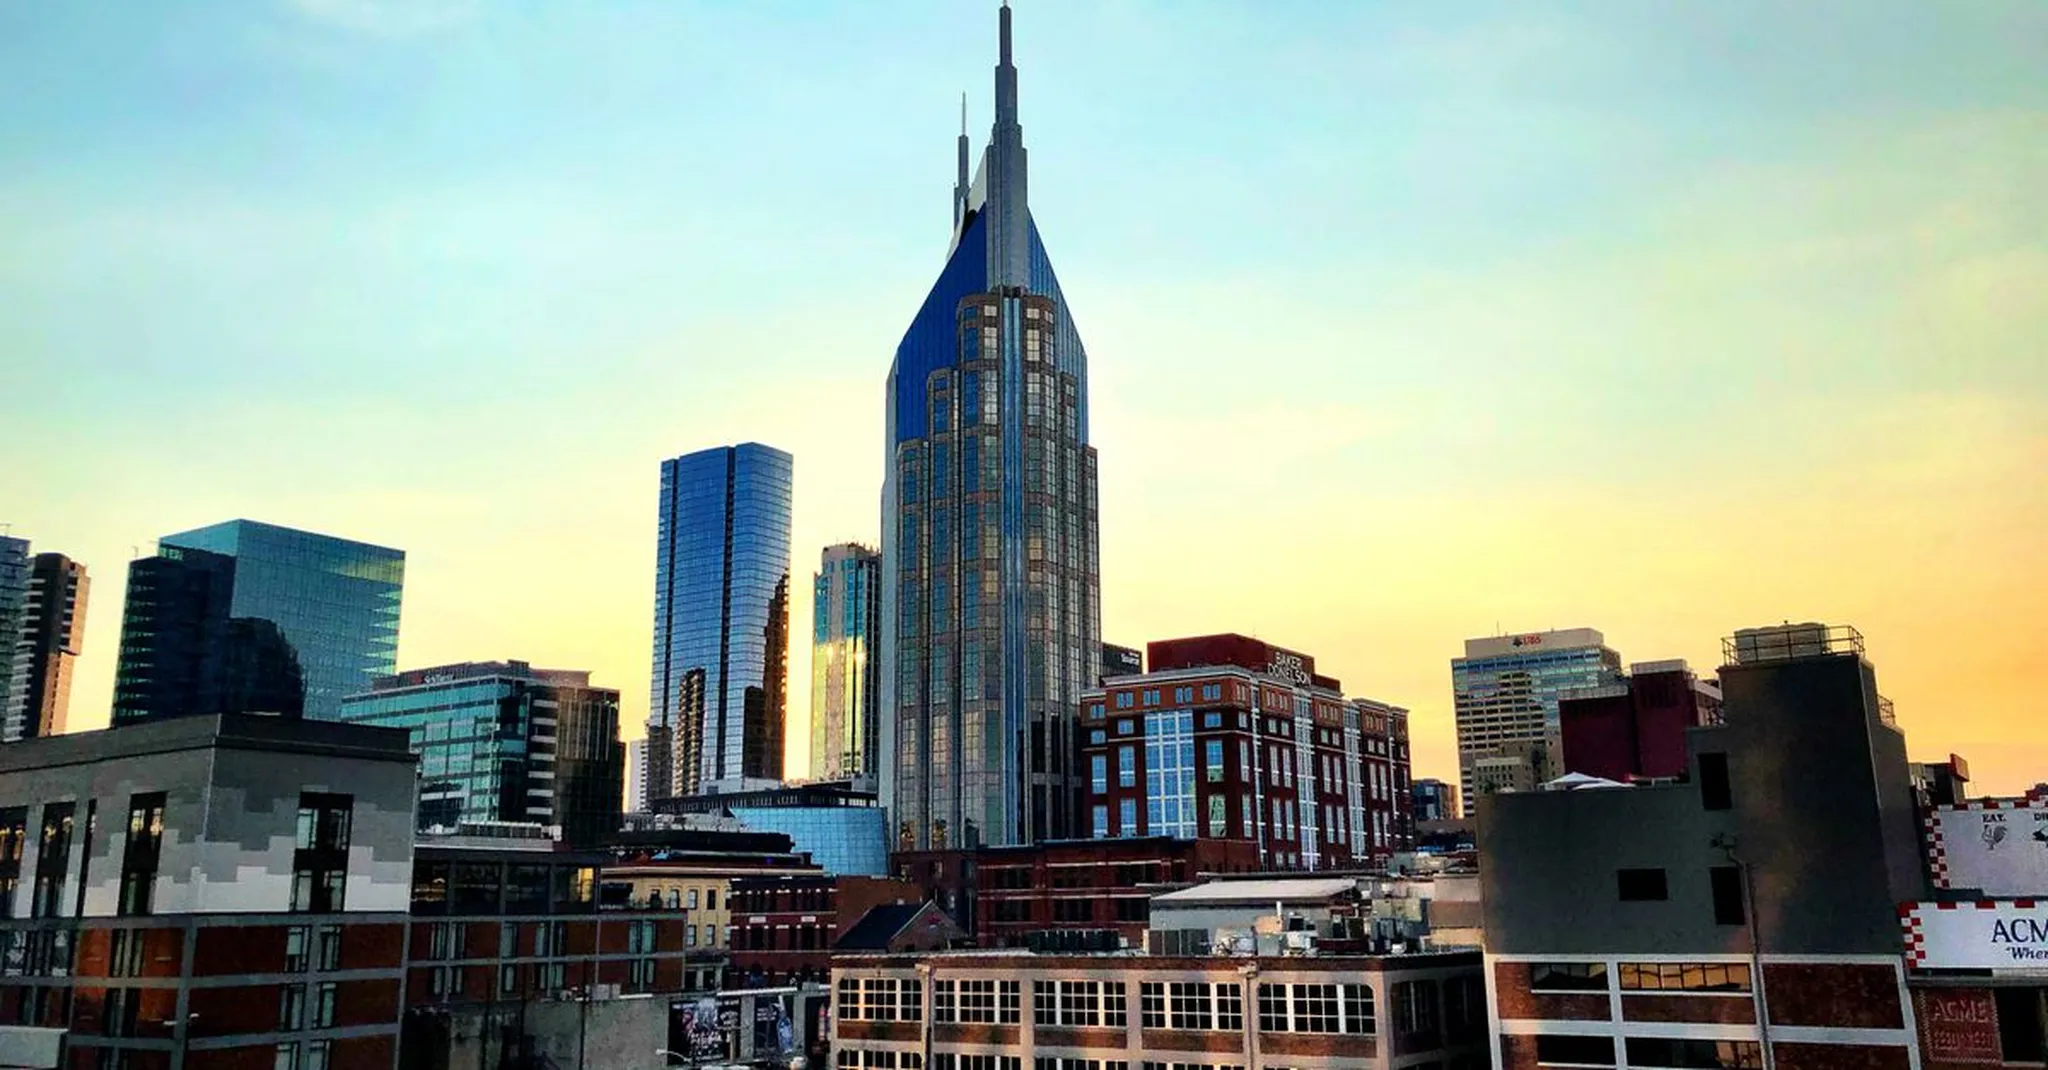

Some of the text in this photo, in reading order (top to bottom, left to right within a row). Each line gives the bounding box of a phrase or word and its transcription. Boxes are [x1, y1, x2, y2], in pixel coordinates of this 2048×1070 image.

[1274, 651, 1302, 670] BAKER
[1267, 662, 1311, 687] DONELSON
[1931, 998, 1990, 1023] ACME
